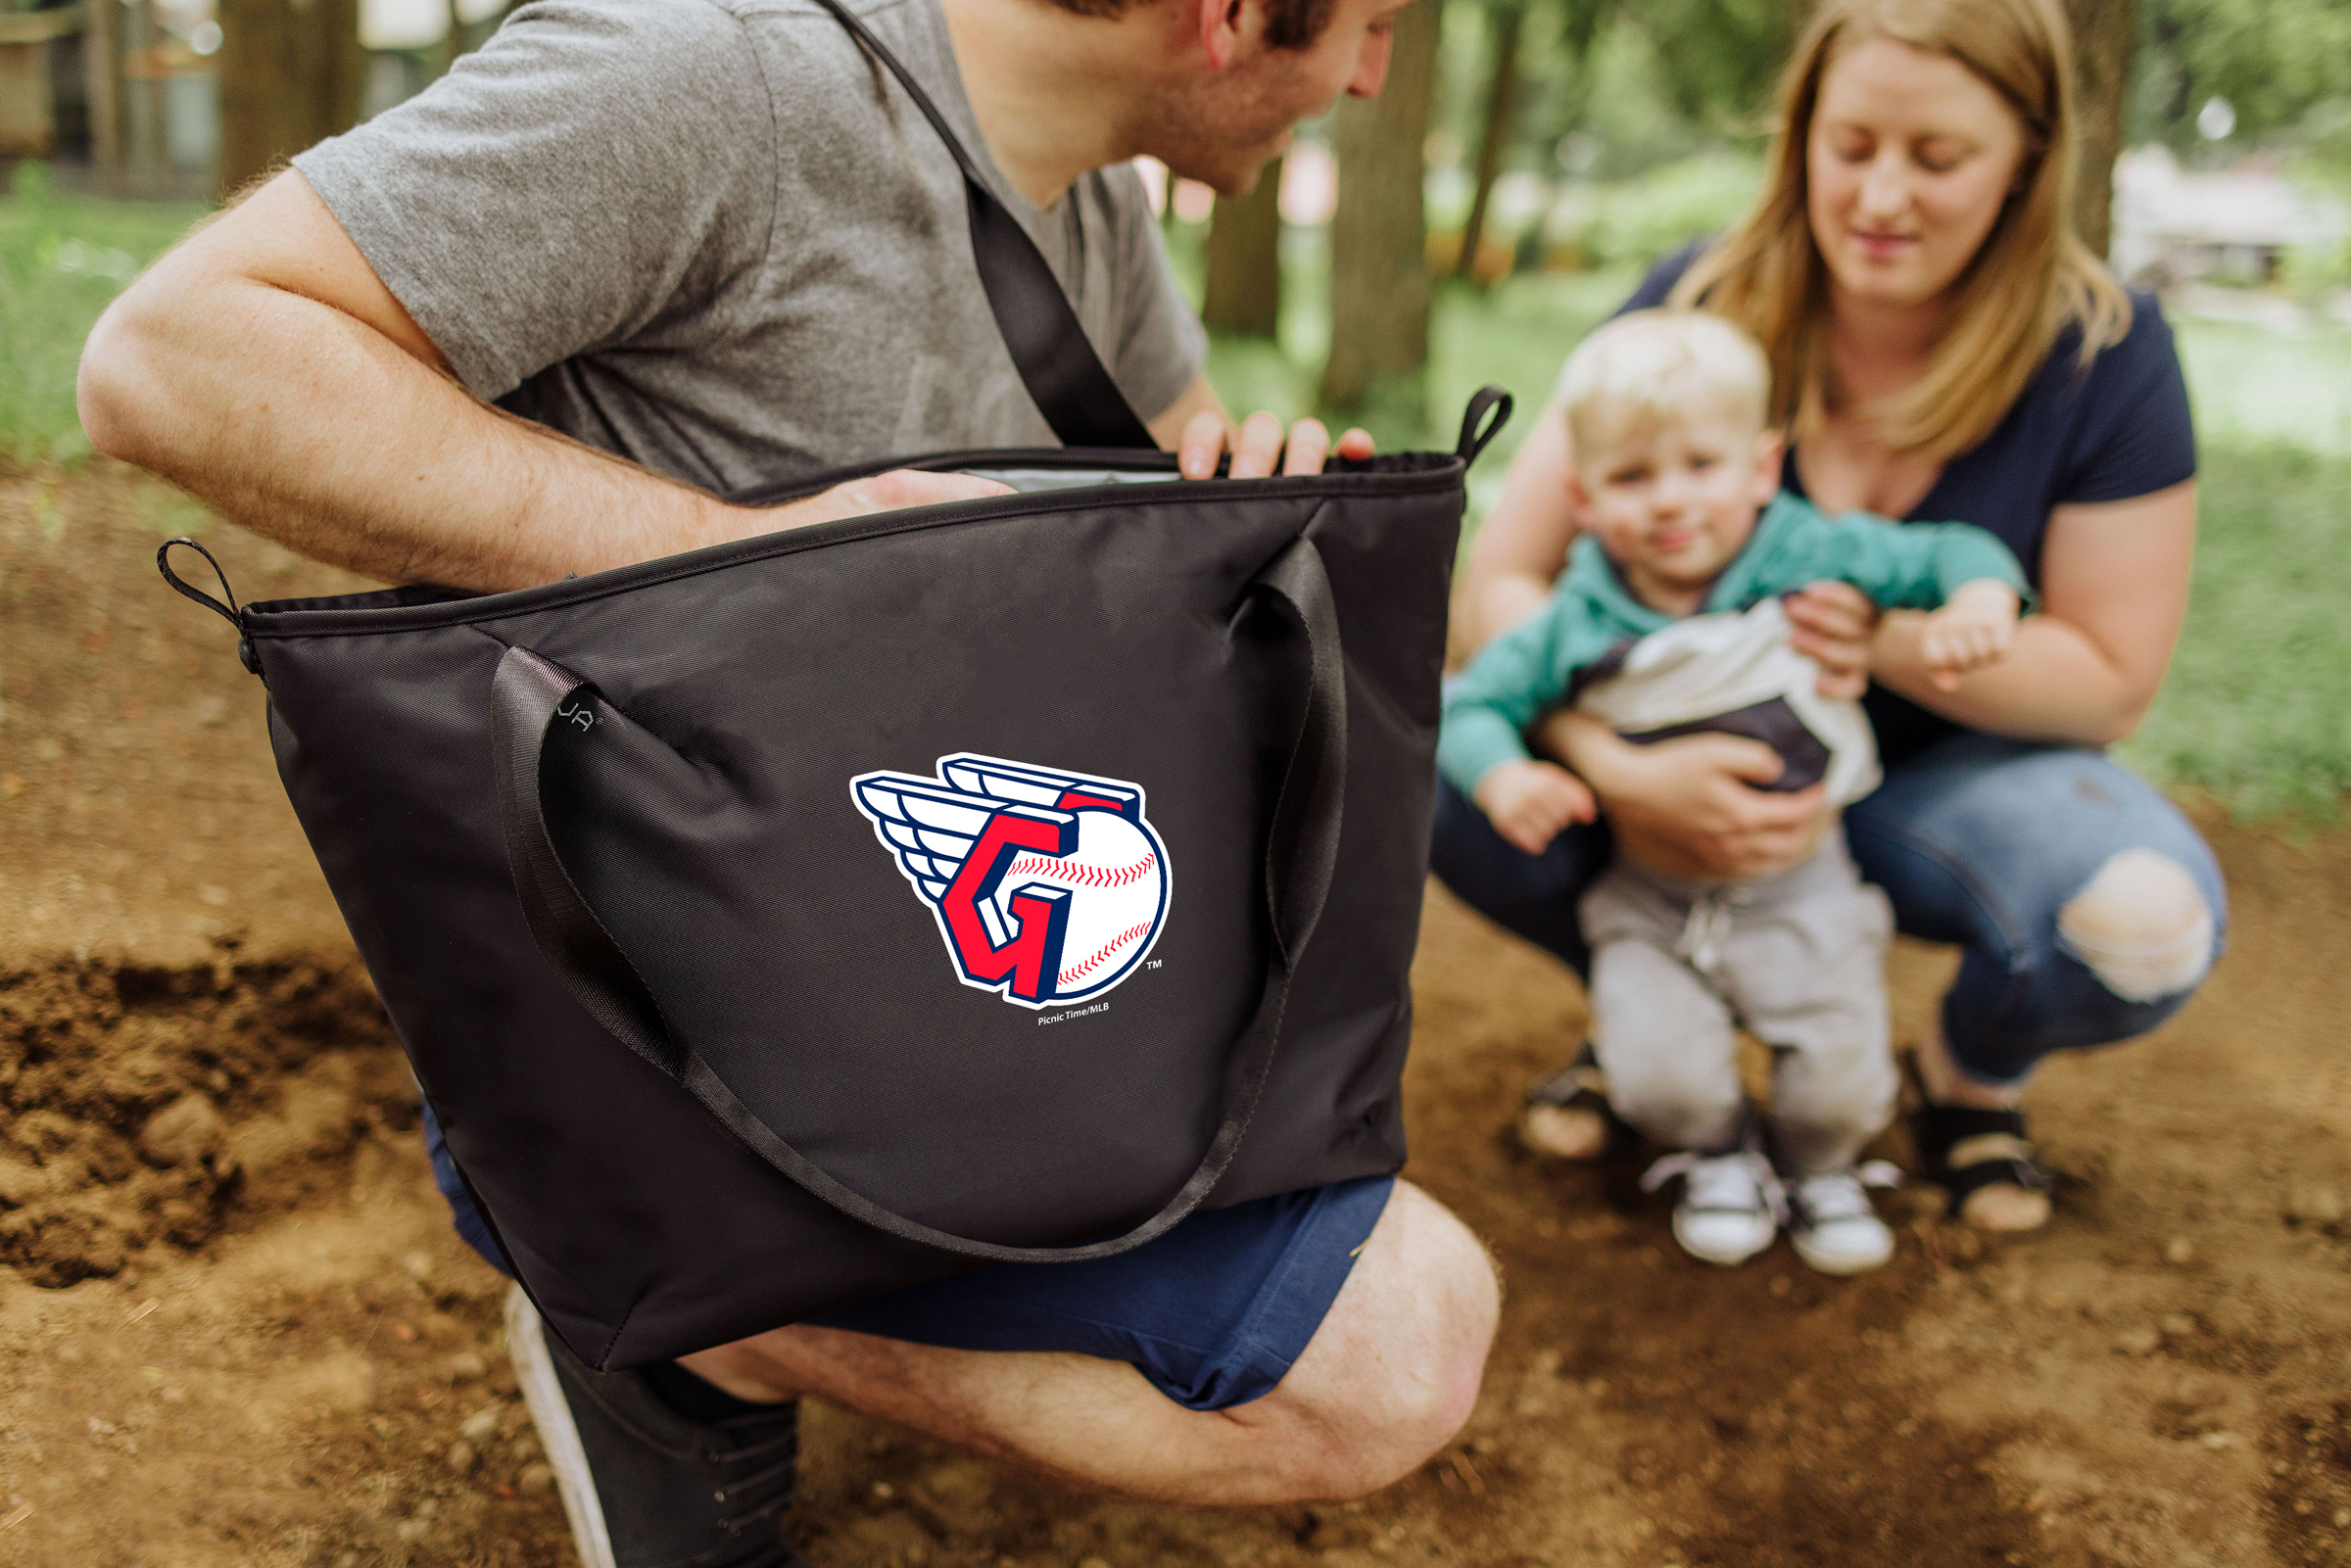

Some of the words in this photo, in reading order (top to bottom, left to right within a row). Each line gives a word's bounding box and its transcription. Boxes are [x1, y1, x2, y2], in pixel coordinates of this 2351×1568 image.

[1146, 959, 1163, 971] TM
[1037, 1013, 1065, 1026] Picnic
[1065, 1002, 1109, 1020] Time/MLB
